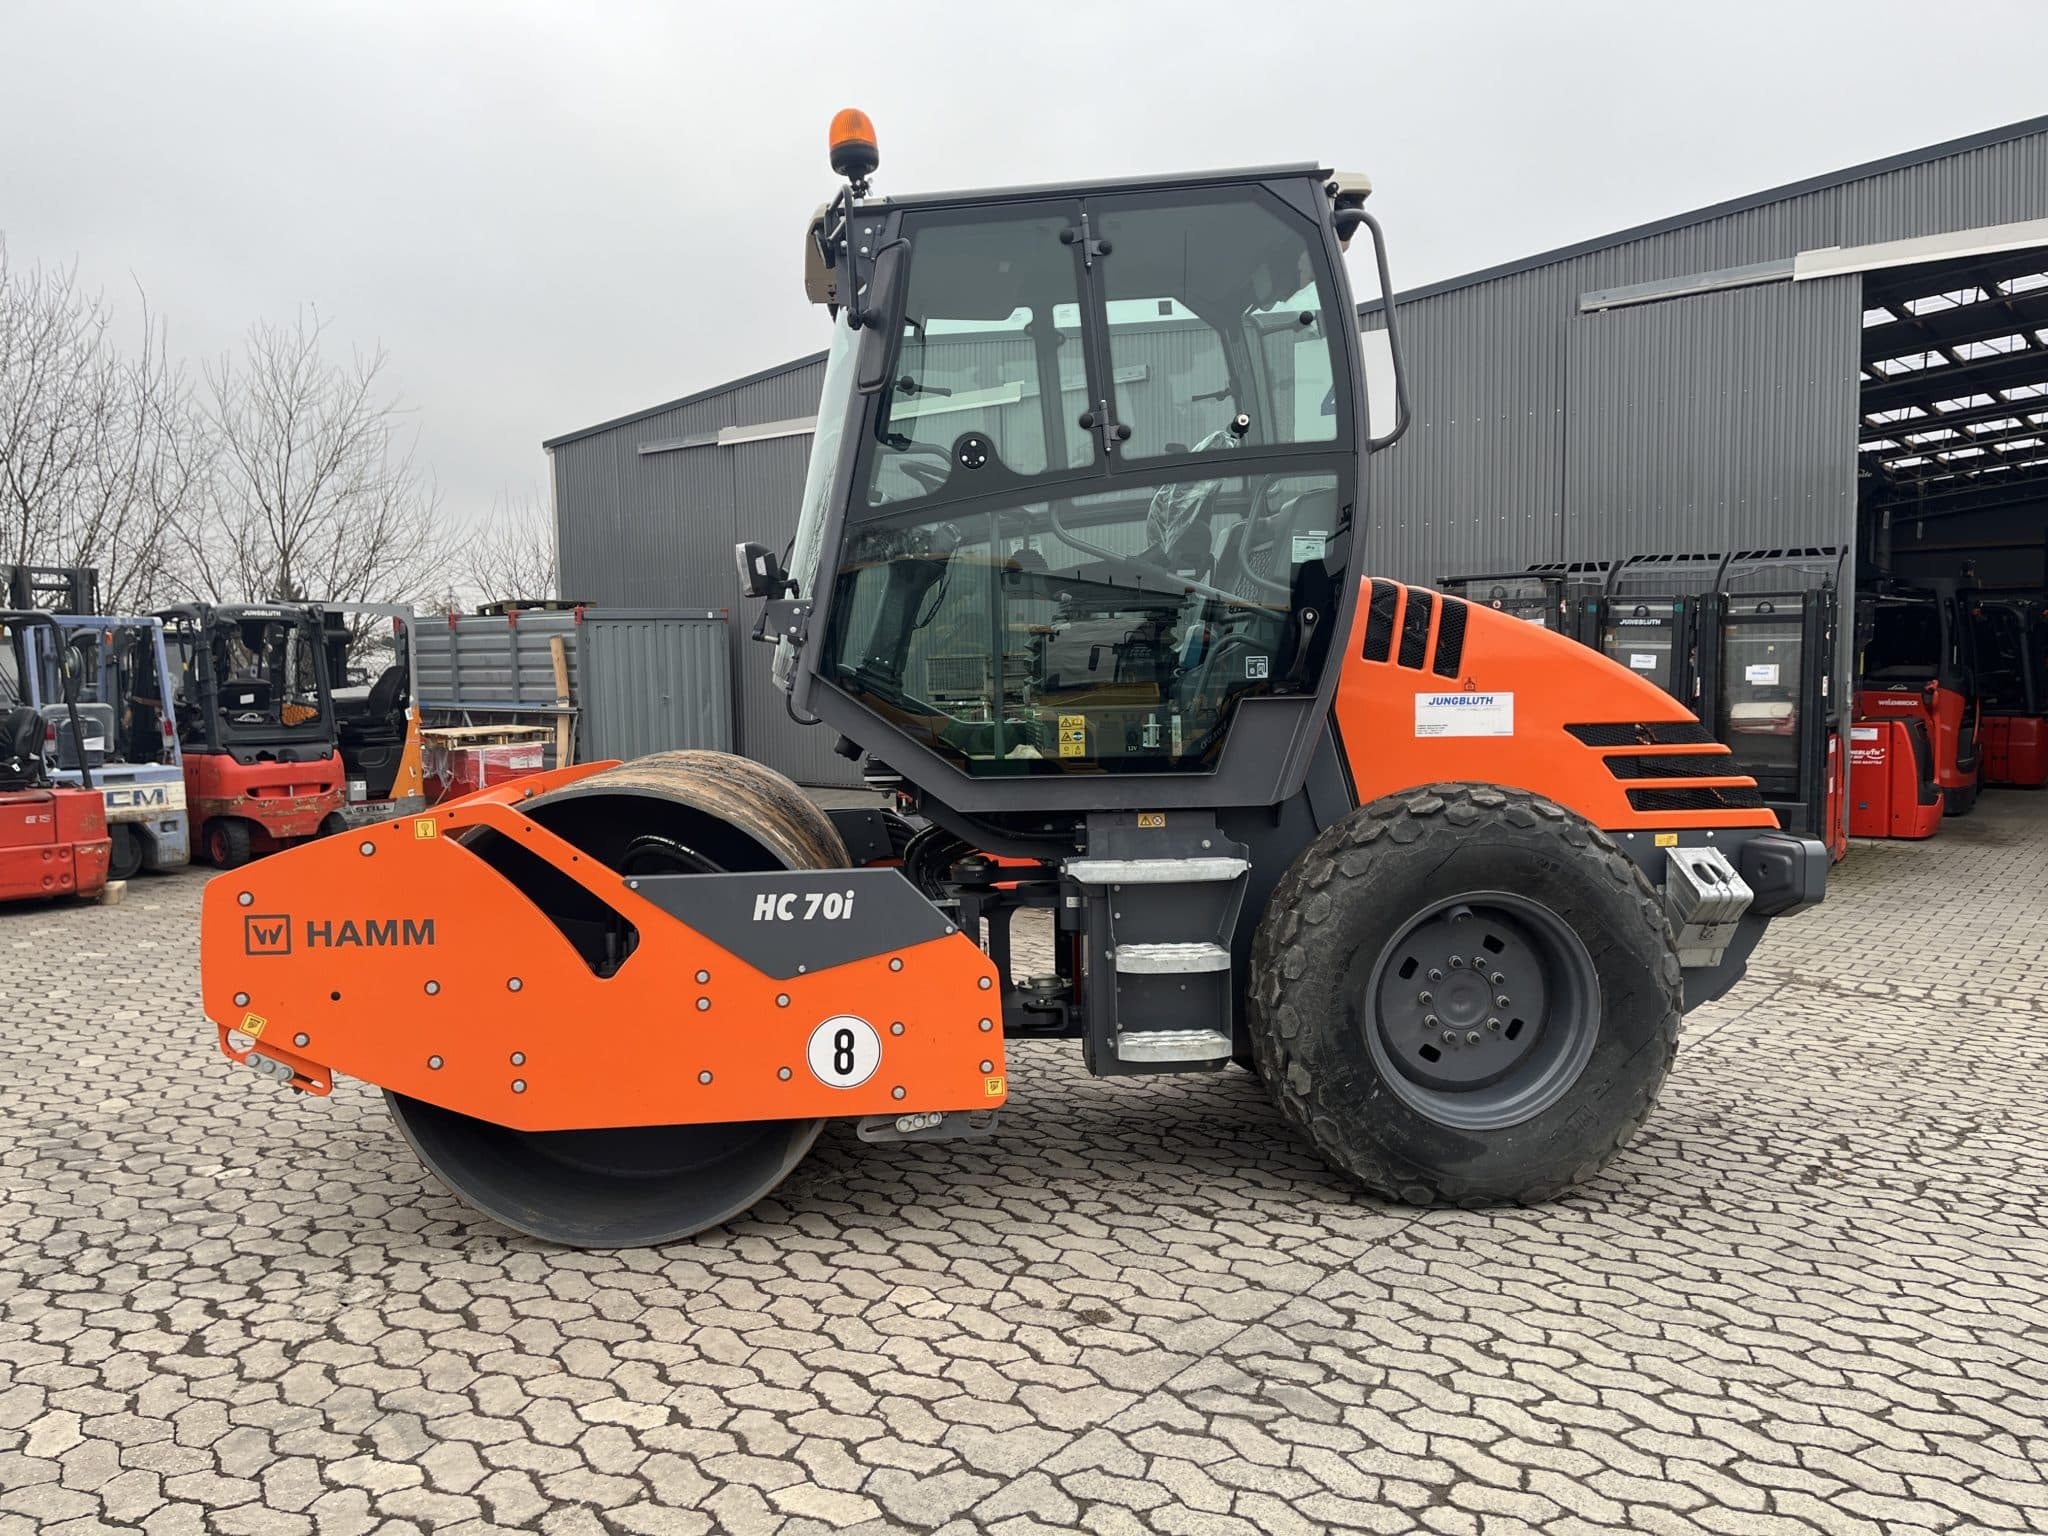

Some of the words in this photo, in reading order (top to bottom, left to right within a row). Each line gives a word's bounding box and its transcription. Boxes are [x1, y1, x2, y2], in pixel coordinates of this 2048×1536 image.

[1428, 696, 1494, 705] JUNGBLUTH
[106, 788, 165, 807] CM
[753, 893, 798, 921] HC
[803, 890, 855, 920] 70i
[306, 919, 435, 948] HAMM
[834, 1028, 855, 1076] 8
